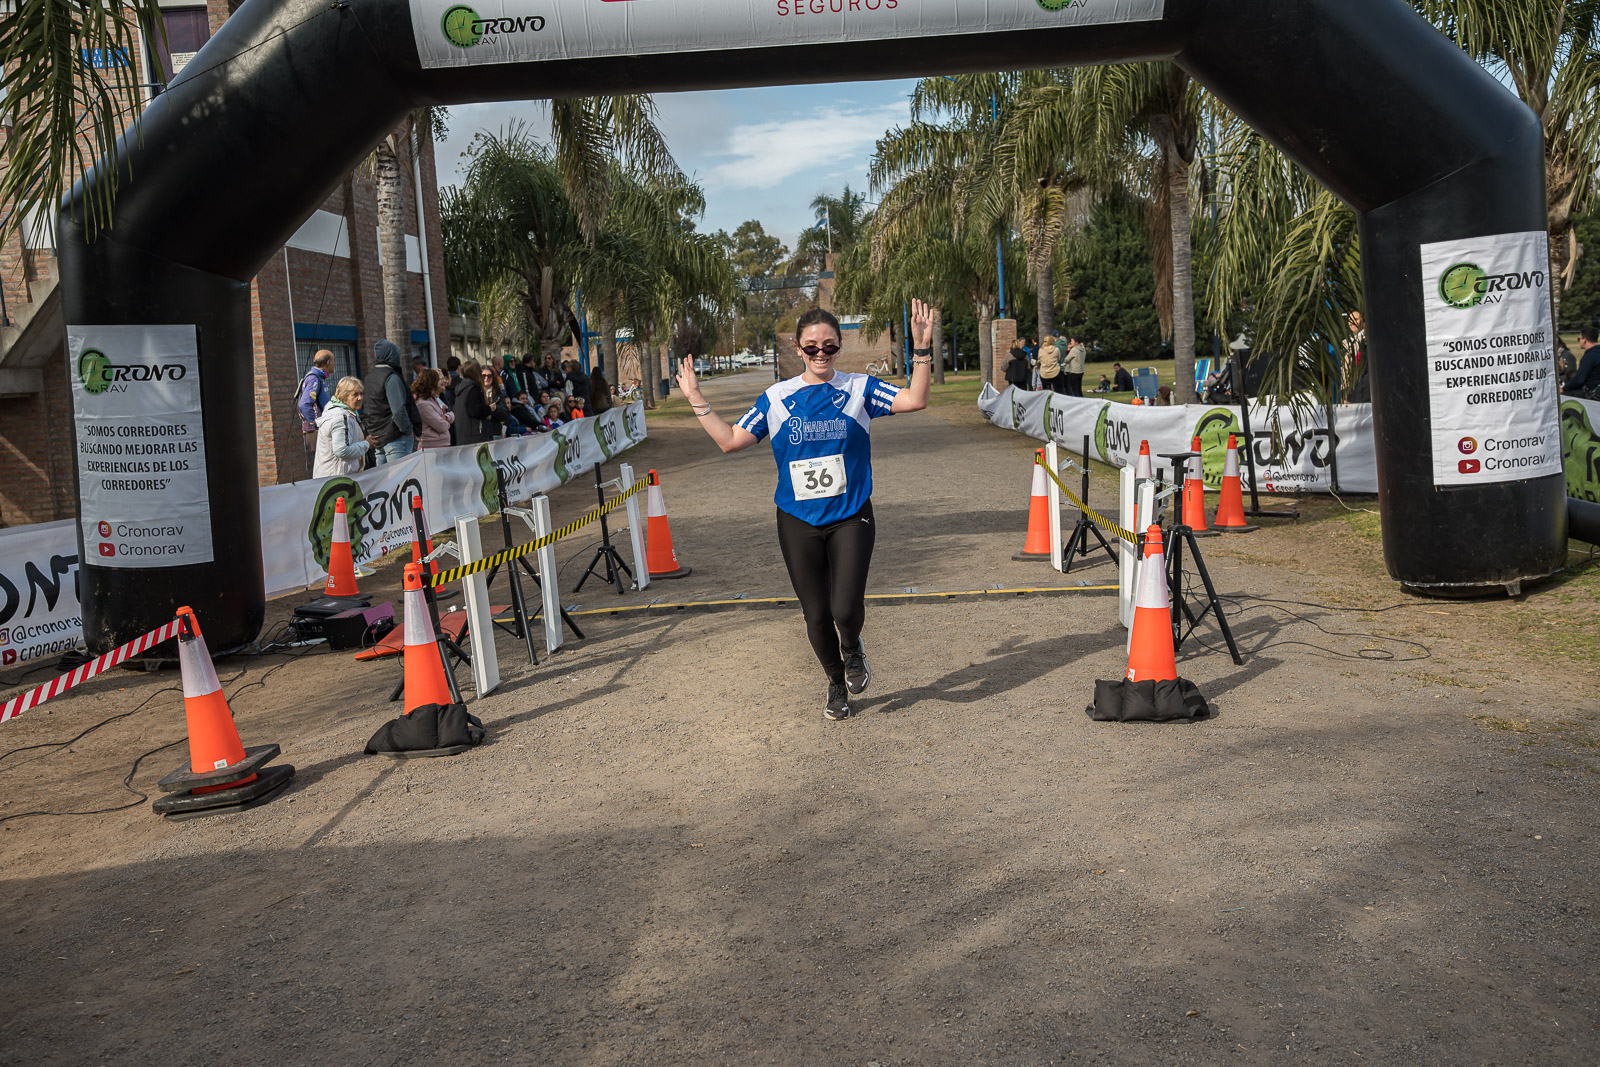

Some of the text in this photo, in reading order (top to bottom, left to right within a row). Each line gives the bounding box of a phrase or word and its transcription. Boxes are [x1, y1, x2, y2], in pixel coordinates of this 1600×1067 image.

[777, 0, 898, 16] SEGUROS
[471, 15, 545, 35] CRONO
[471, 37, 497, 45] RAV
[1473, 270, 1544, 293] CRONO
[1472, 294, 1502, 305] RAV
[1490, 332, 1544, 348] CORREDORES
[1435, 349, 1551, 371] BUSCANDO MEJORAR LAS
[101, 364, 186, 381] CRONO
[1446, 368, 1547, 388] EXPERIENCIAS DE LOS
[101, 384, 128, 393] RAV
[117, 424, 187, 437] CORREDORES
[789, 416, 802, 445] 3
[80, 441, 197, 455] BUSCANDO MEJORAR LAS
[1484, 436, 1546, 451] Cronorav
[87, 460, 189, 472] EXPERIENCIAS DE LOS
[1485, 454, 1546, 470] Cronorav
[803, 468, 833, 490] 36
[117, 525, 184, 537] Cronorav
[119, 543, 185, 555] Cronorav
